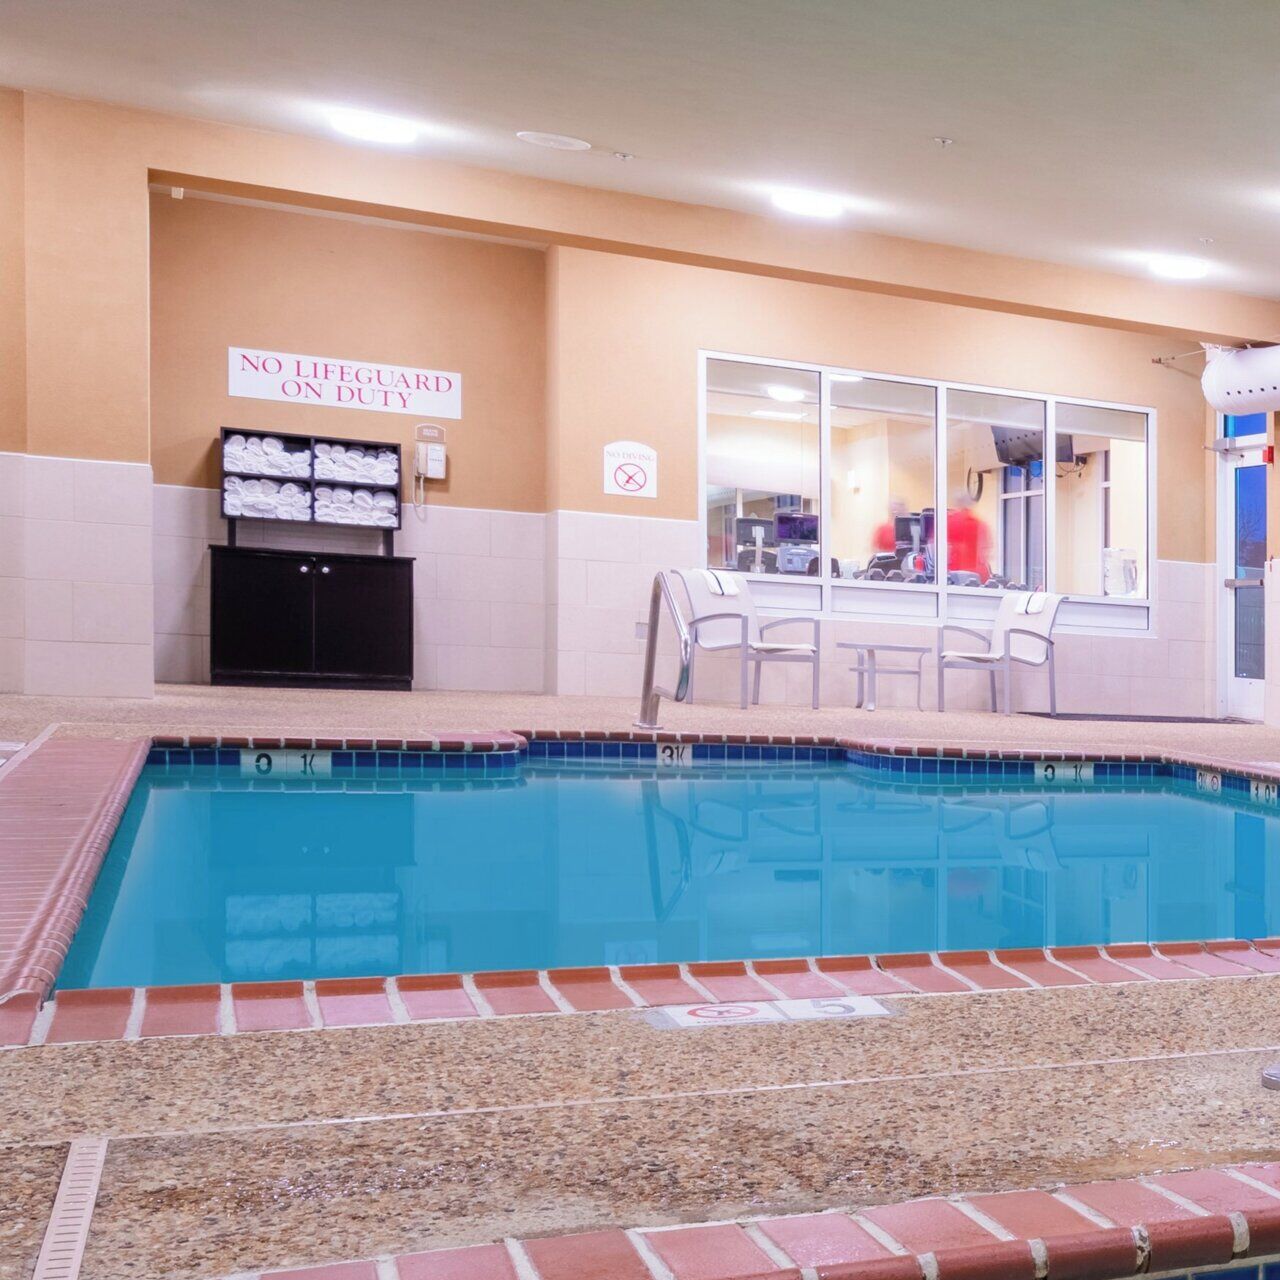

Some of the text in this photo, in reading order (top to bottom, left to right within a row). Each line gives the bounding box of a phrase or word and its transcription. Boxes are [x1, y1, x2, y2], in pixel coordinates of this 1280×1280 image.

[241, 353, 453, 394] NO LIFEGUARD
[281, 379, 412, 409] ON DUTY
[812, 999, 856, 1015] 5
